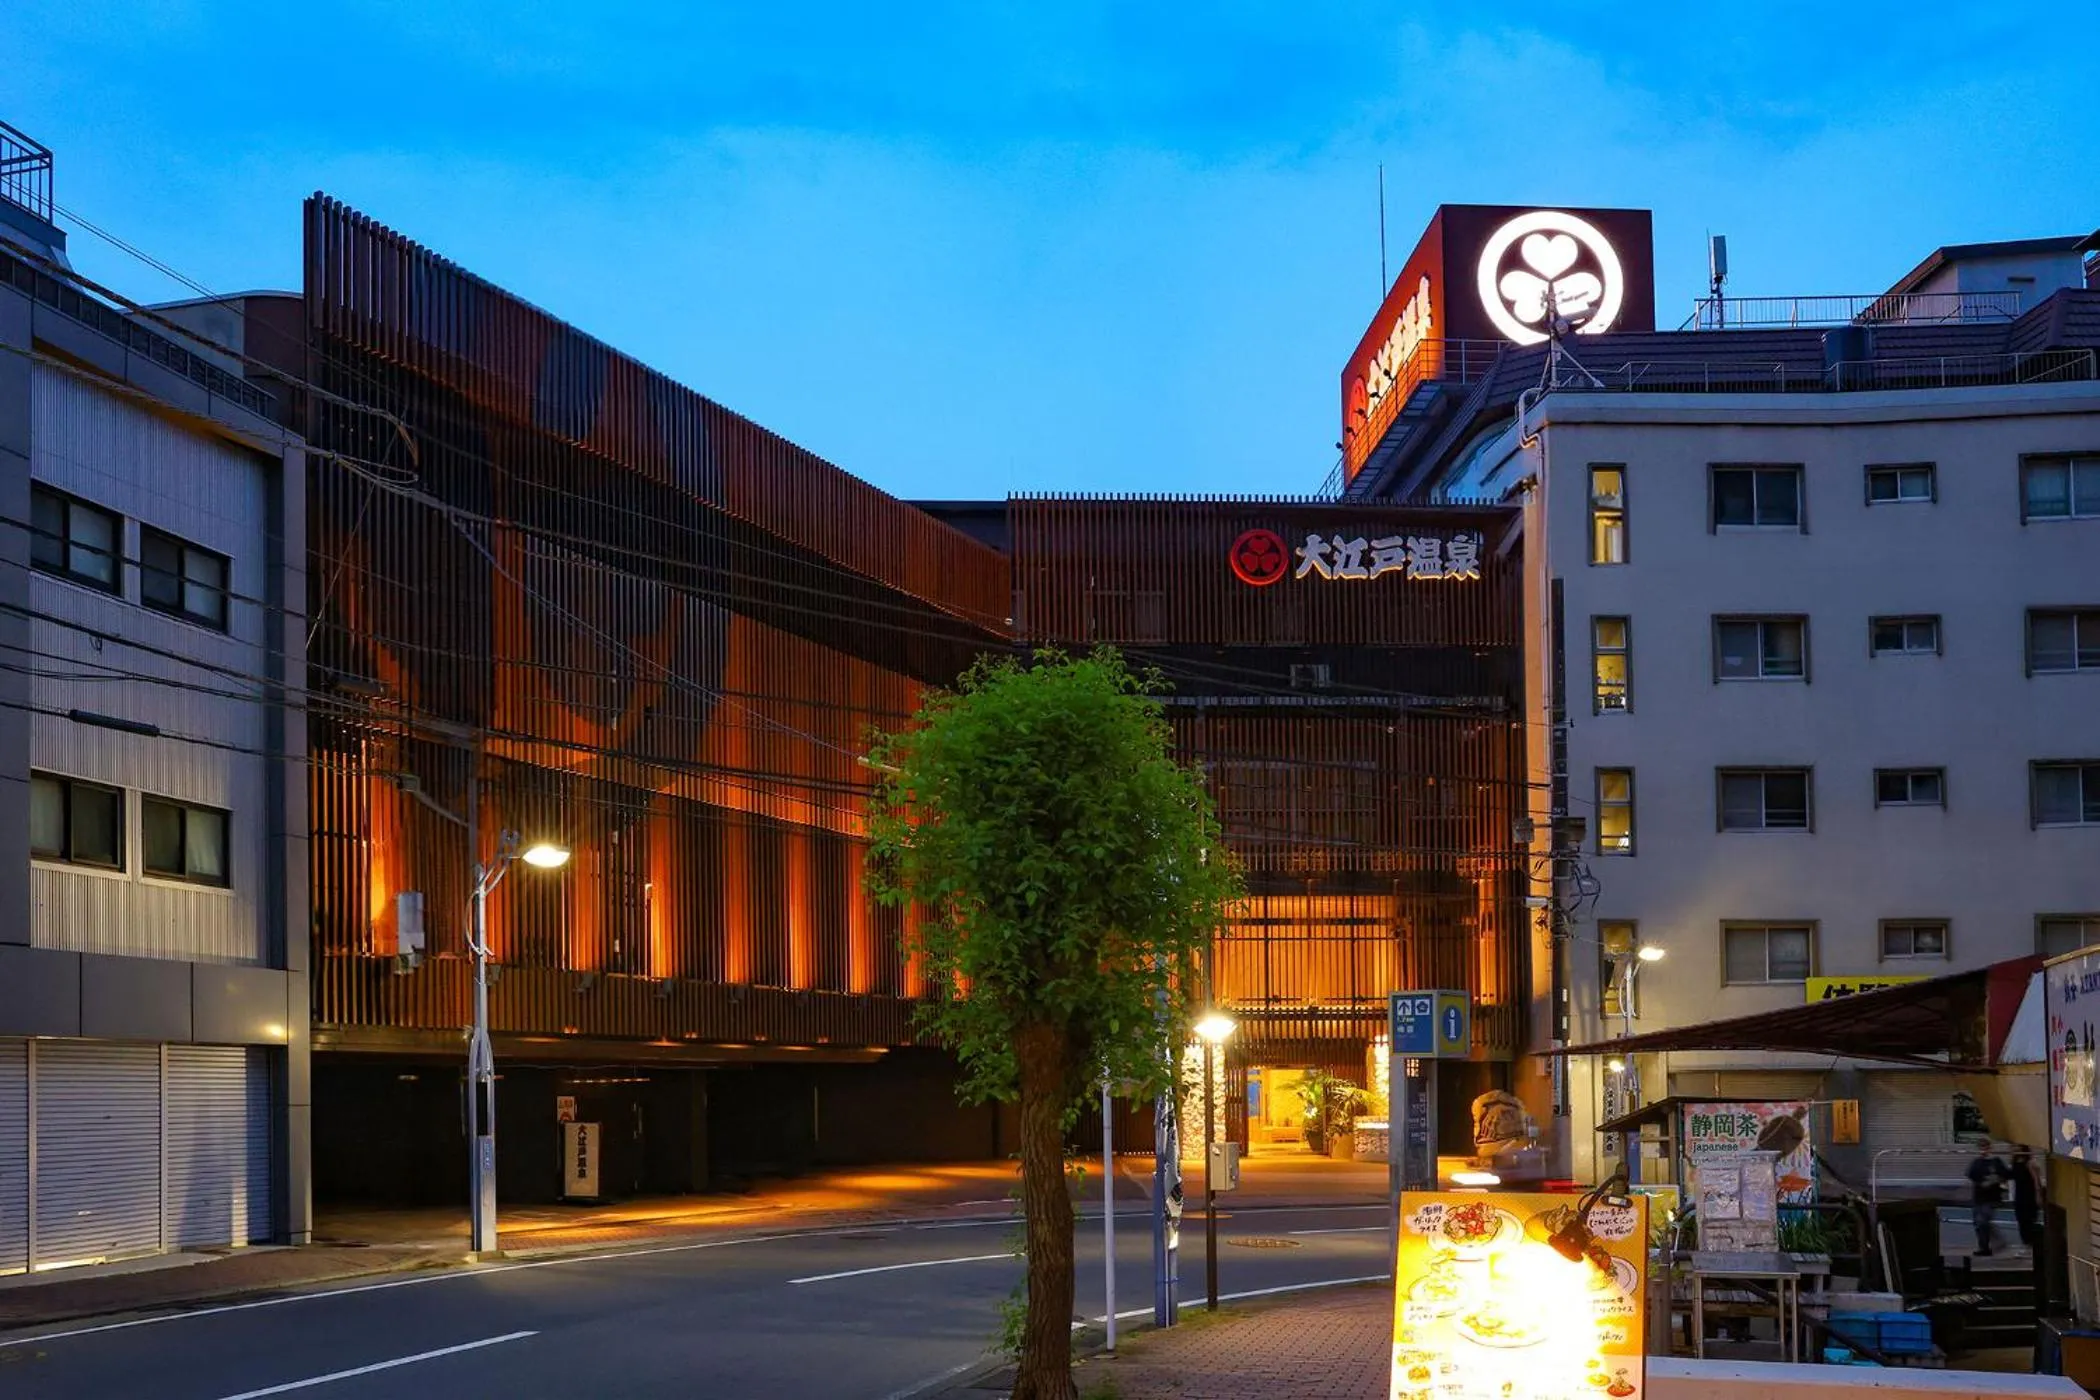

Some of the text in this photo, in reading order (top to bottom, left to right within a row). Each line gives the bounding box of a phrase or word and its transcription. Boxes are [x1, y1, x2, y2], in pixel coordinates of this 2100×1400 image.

[1296, 534, 1481, 581] 大江戸温泉
[1690, 1113, 1758, 1137] 静岡茶
